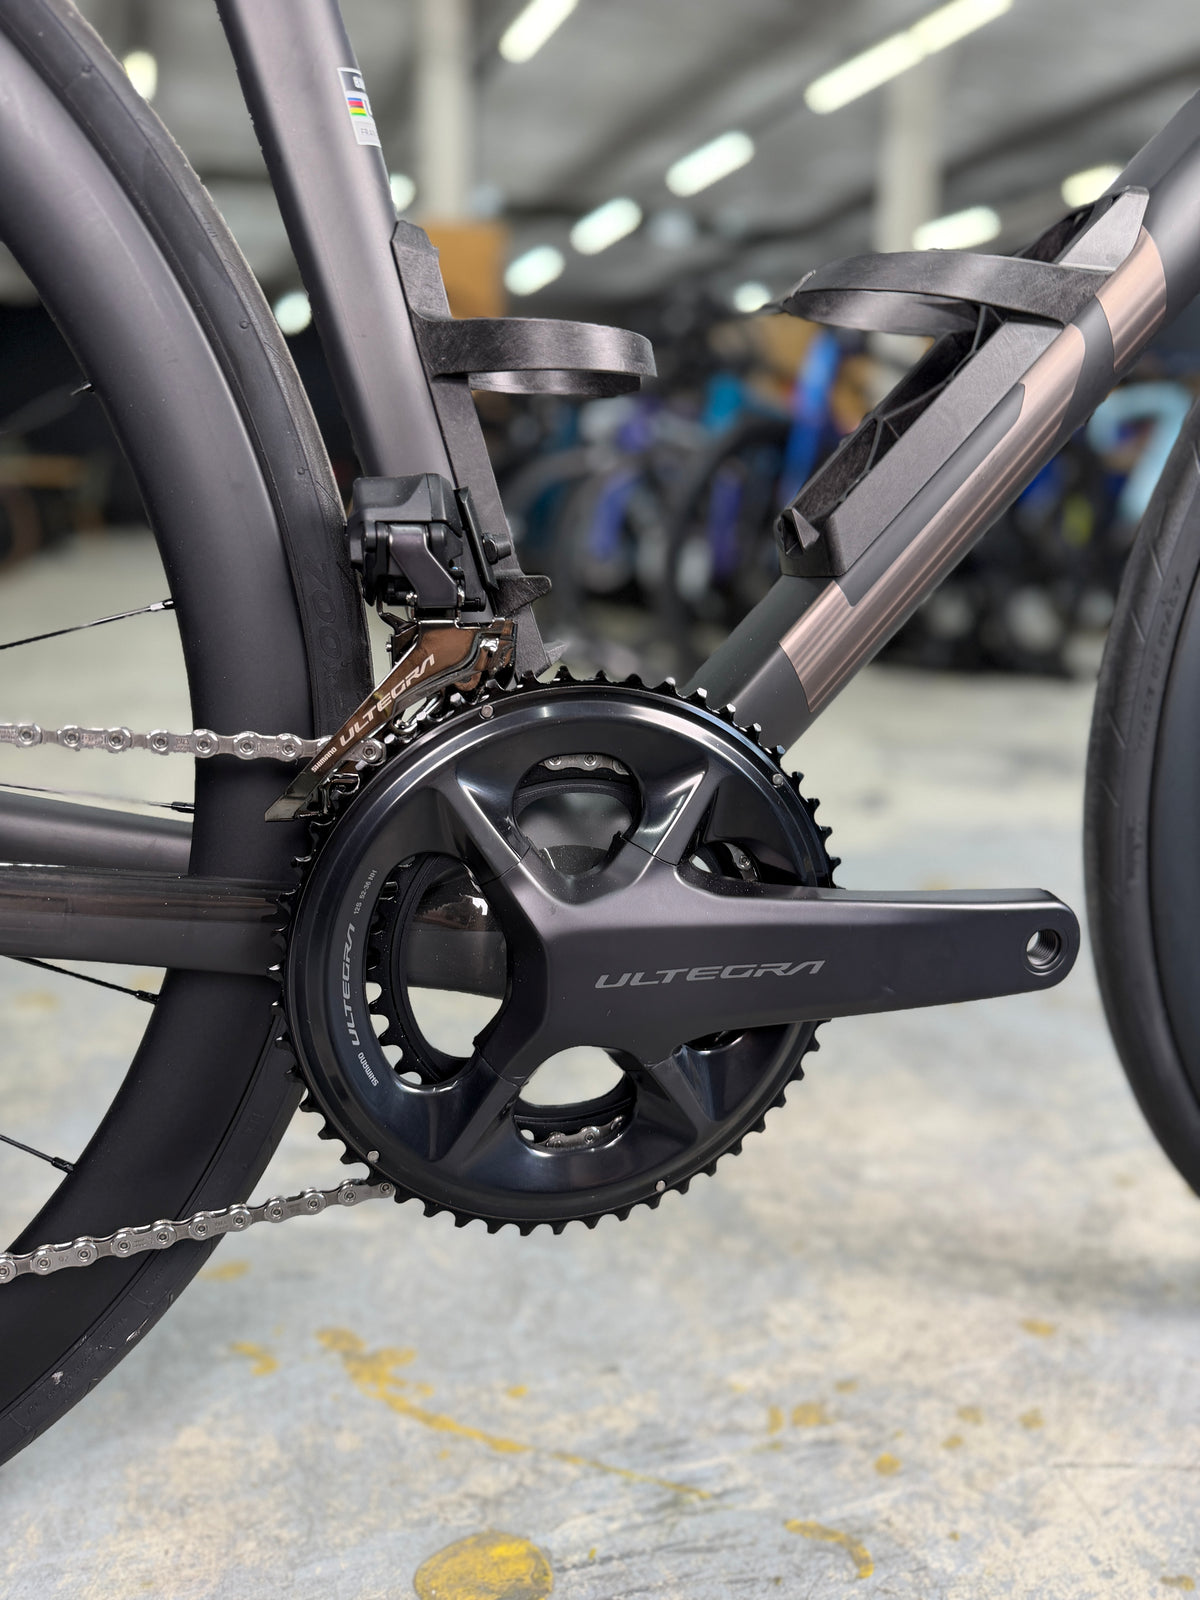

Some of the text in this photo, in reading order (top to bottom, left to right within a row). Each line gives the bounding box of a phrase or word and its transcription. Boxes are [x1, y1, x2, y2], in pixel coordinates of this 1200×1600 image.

[311, 746, 338, 773] SHIMANO
[340, 653, 435, 747] ULTEGRA
[353, 901, 362, 915] 12S
[359, 880, 372, 899] 52-36
[342, 922, 379, 1087] SHIMANO ULTEGRA
[594, 960, 826, 989] ULTEGRA
